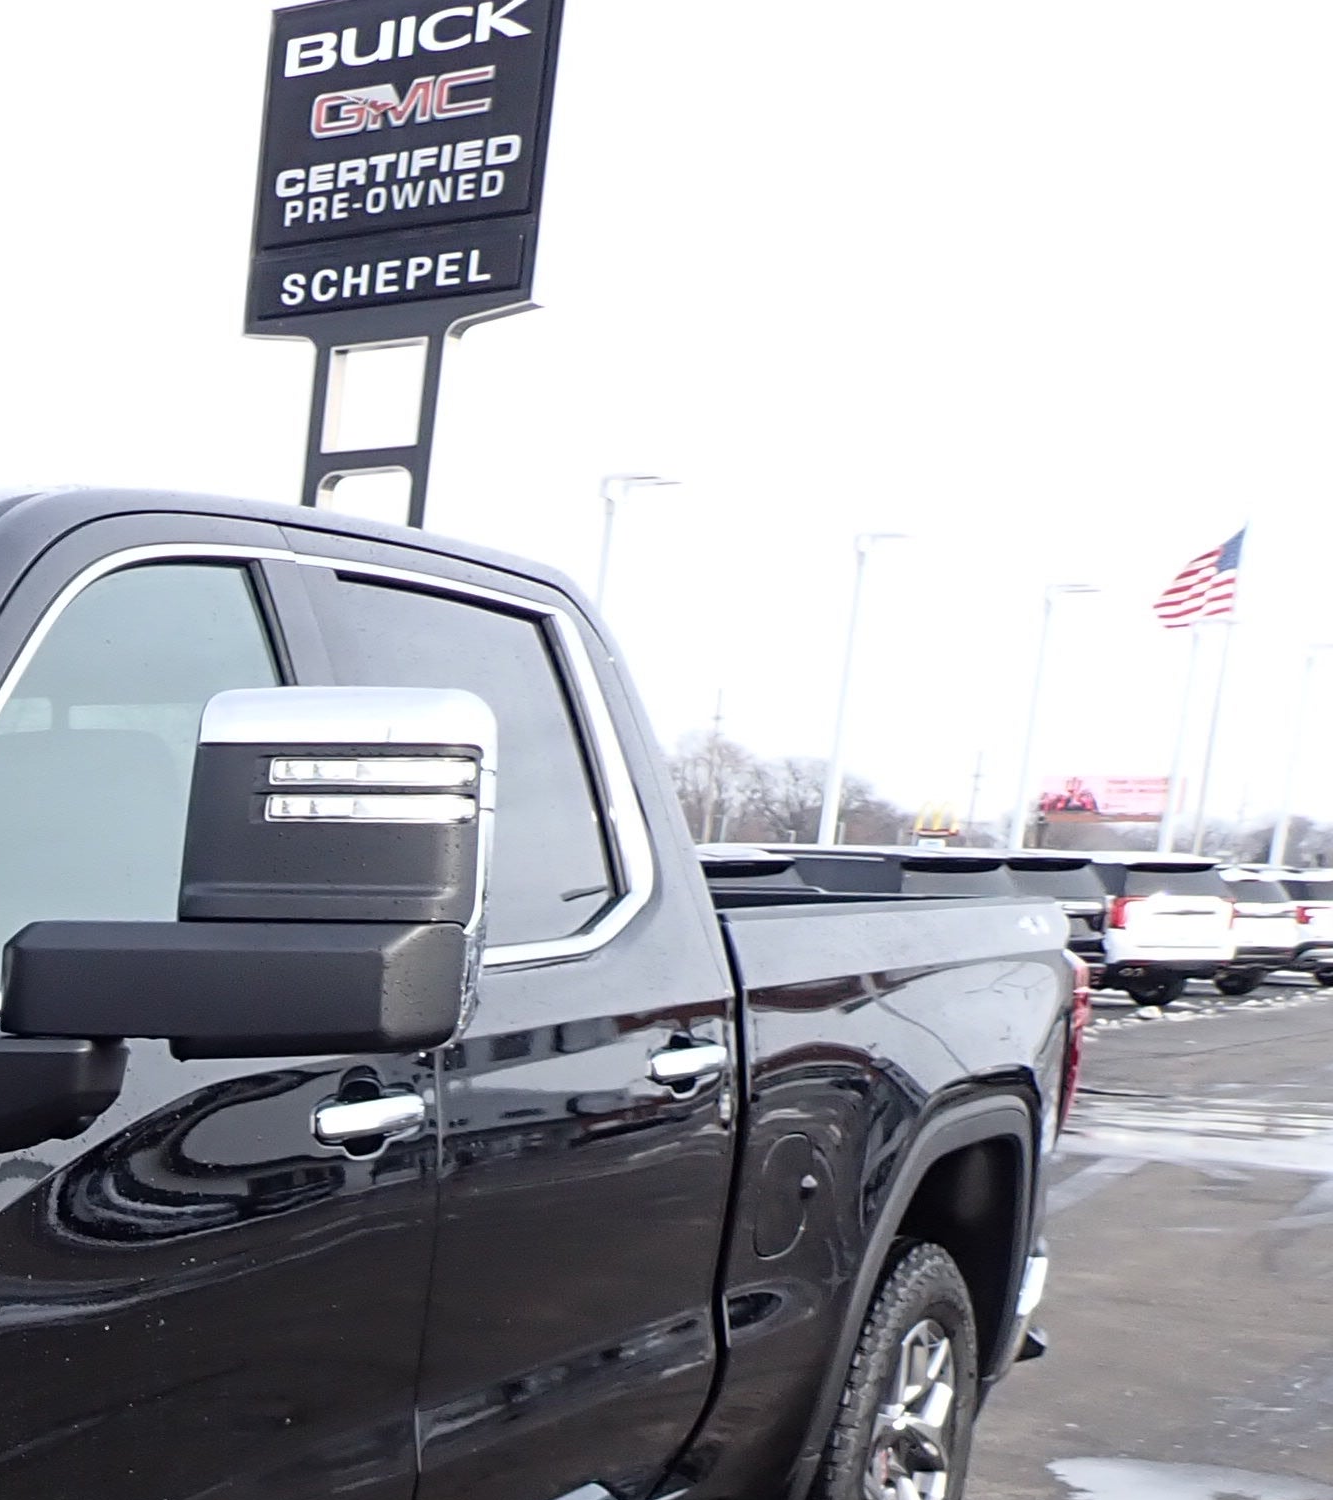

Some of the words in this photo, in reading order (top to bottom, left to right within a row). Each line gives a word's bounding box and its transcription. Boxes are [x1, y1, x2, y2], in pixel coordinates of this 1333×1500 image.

[284, 0, 532, 77] BUICK
[311, 65, 496, 138] GMC
[275, 134, 522, 198] CERTIFIED
[284, 170, 505, 227] PRE-OWNED
[281, 249, 491, 306] SCHEPEL
